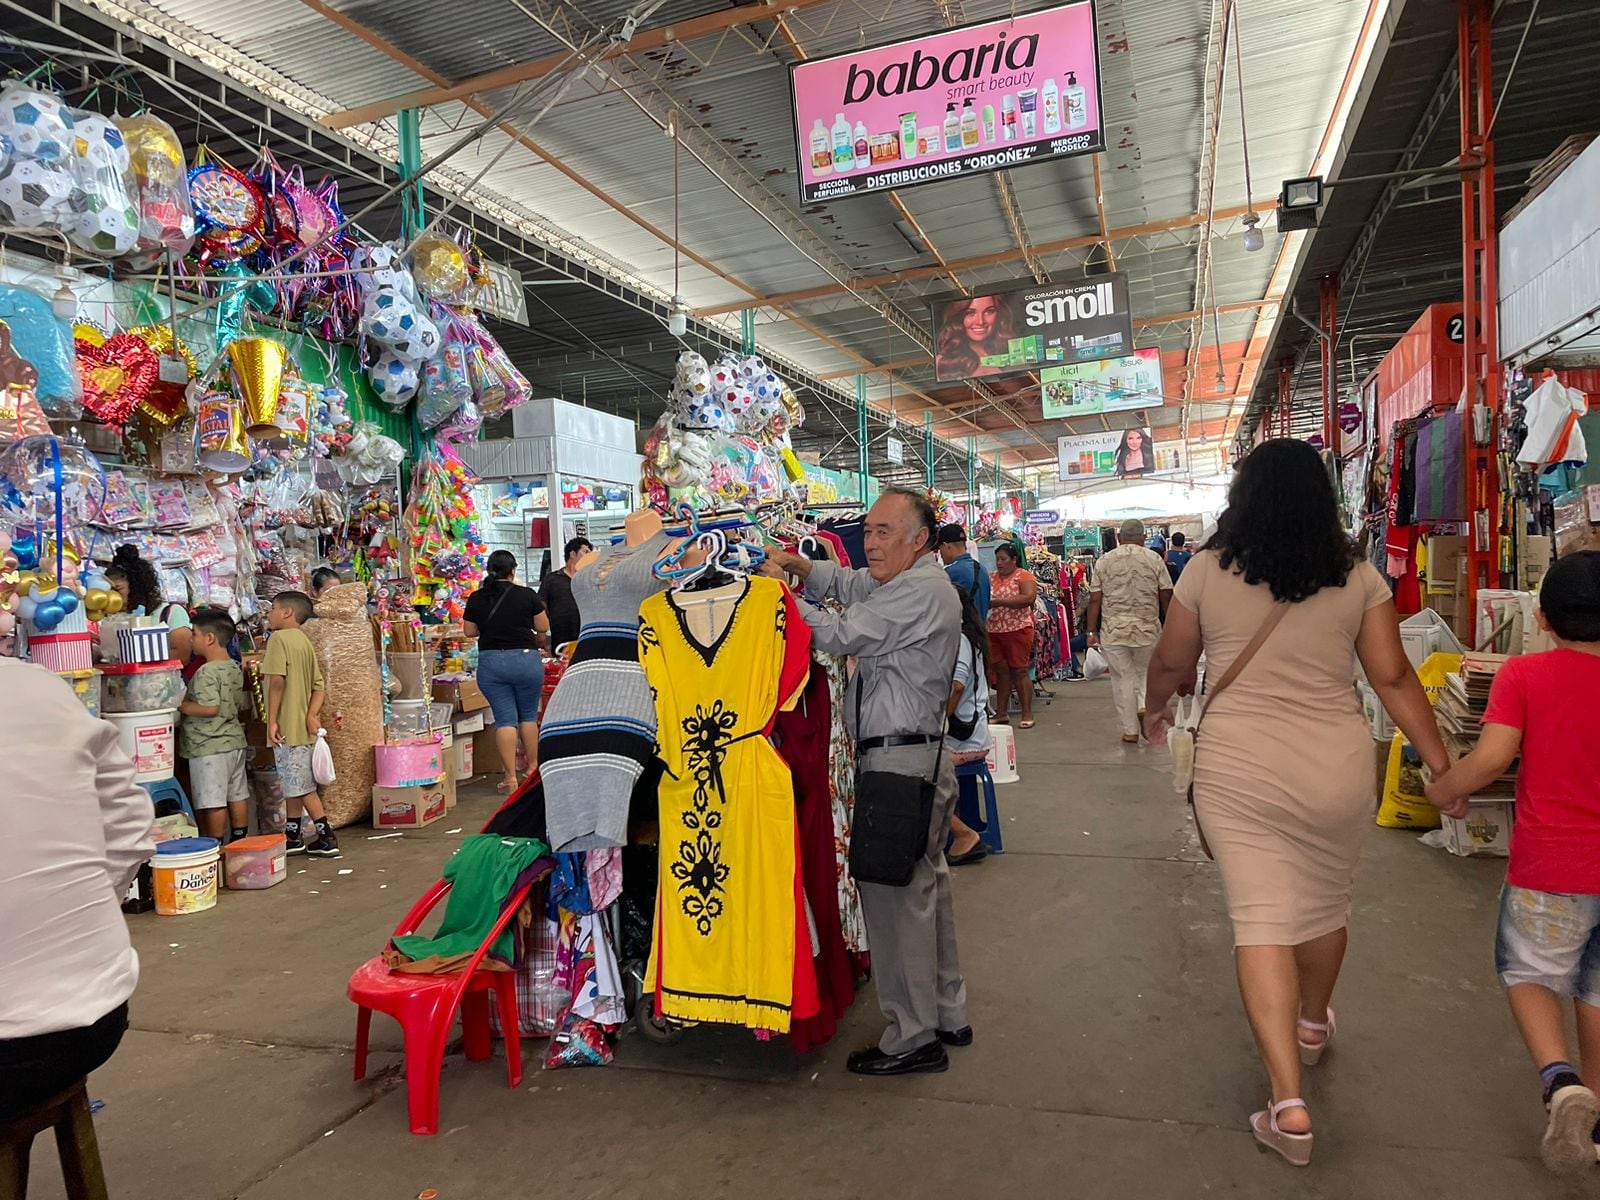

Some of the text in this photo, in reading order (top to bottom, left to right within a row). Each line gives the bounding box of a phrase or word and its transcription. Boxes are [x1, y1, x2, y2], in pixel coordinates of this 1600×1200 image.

[843, 32, 1040, 105] babaria
[947, 71, 1035, 100] smart beauty
[1050, 135, 1091, 148] MERCADO
[1053, 142, 1089, 154] MODELO
[866, 160, 962, 188] DISTRIBUCIONES
[813, 184, 856, 198] PERFUMERÍA
[819, 179, 849, 190] SECCIÓN
[1024, 290, 1064, 300] COLORACIÓN
[1074, 285, 1096, 293] CREMA
[1025, 282, 1114, 327] smoll
[1450, 318, 1463, 340] 2
[1120, 358, 1143, 367] issue
[1063, 440, 1100, 448] PLACENTA
[190, 873, 200, 881] La
